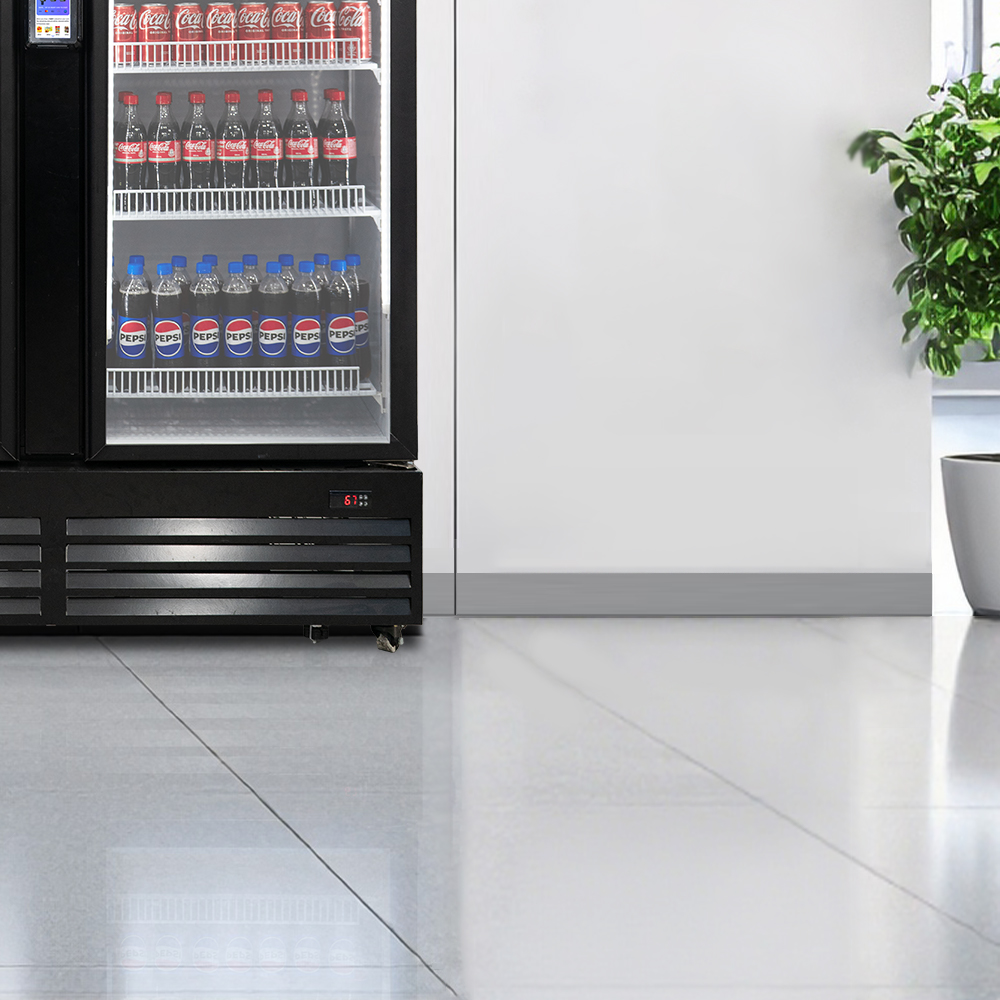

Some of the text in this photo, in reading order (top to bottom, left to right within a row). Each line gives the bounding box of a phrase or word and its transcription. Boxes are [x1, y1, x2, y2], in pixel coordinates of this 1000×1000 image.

[118, 143, 140, 152] Coca-Cola
[185, 141, 207, 150] Coca-Cola
[226, 141, 247, 150] Coca-Cola
[253, 140, 275, 149] Coca-Cola
[288, 139, 310, 148] Coca-Cola
[156, 333, 181, 342] PEPSI
[260, 332, 285, 340] PEPSI
[344, 495, 357, 506] 67
